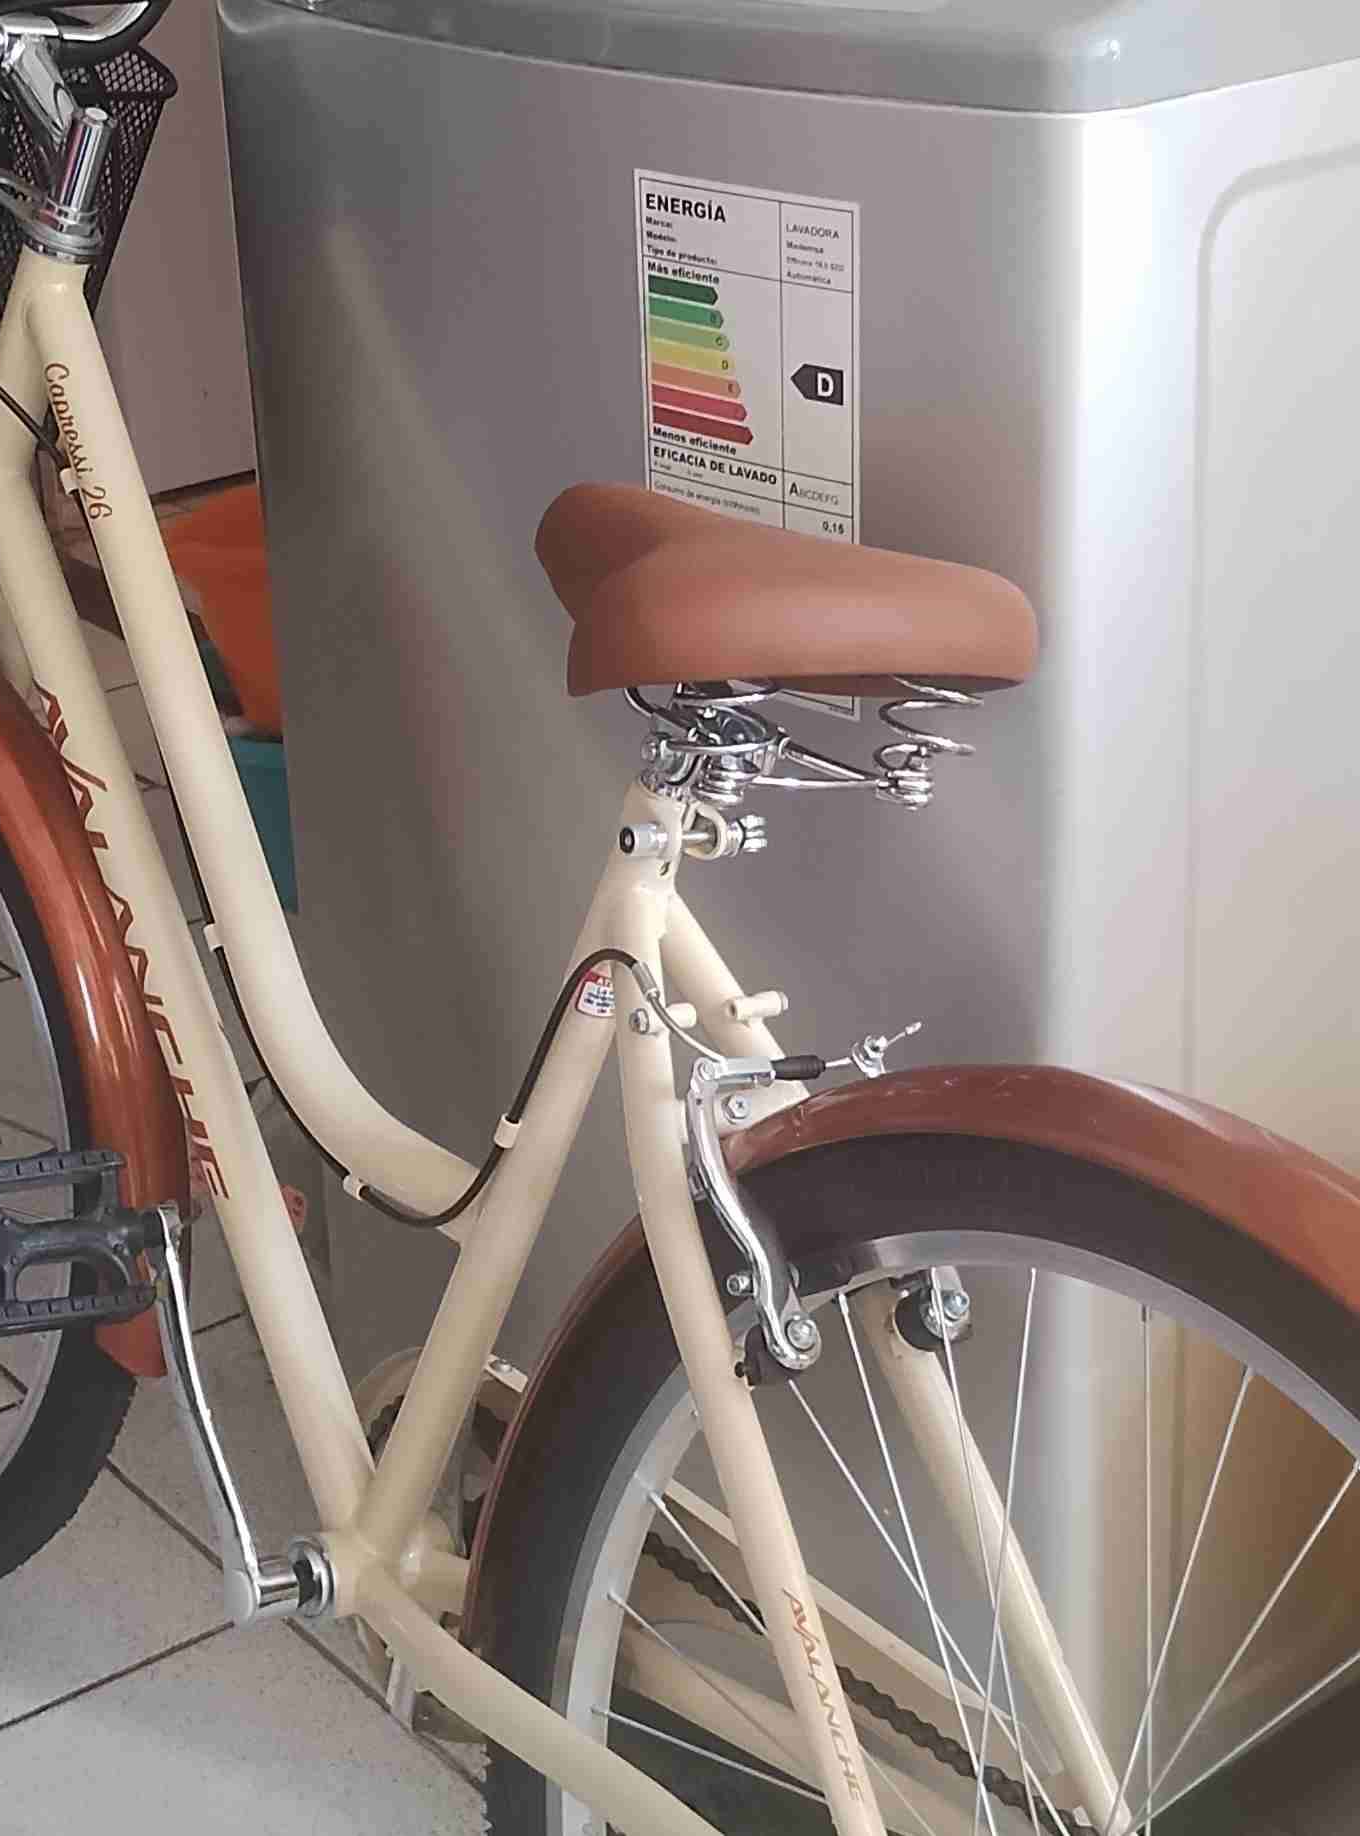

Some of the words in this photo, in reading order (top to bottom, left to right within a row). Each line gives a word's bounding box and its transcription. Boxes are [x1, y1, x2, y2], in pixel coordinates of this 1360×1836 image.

[645, 192, 727, 223] ENERGÍA
[786, 223, 840, 240] LAVADORA
[647, 261, 670, 275] Más
[671, 265, 720, 285] eficiente
[816, 372, 834, 397] D
[653, 426, 687, 444] Menos
[689, 436, 737, 455] eficiente
[653, 446, 706, 469] EFICACIA
[710, 459, 725, 474] DE
[728, 463, 777, 485] LAVADO
[81, 485, 113, 520] 26
[781, 1586, 864, 1803] AVALANCHE
